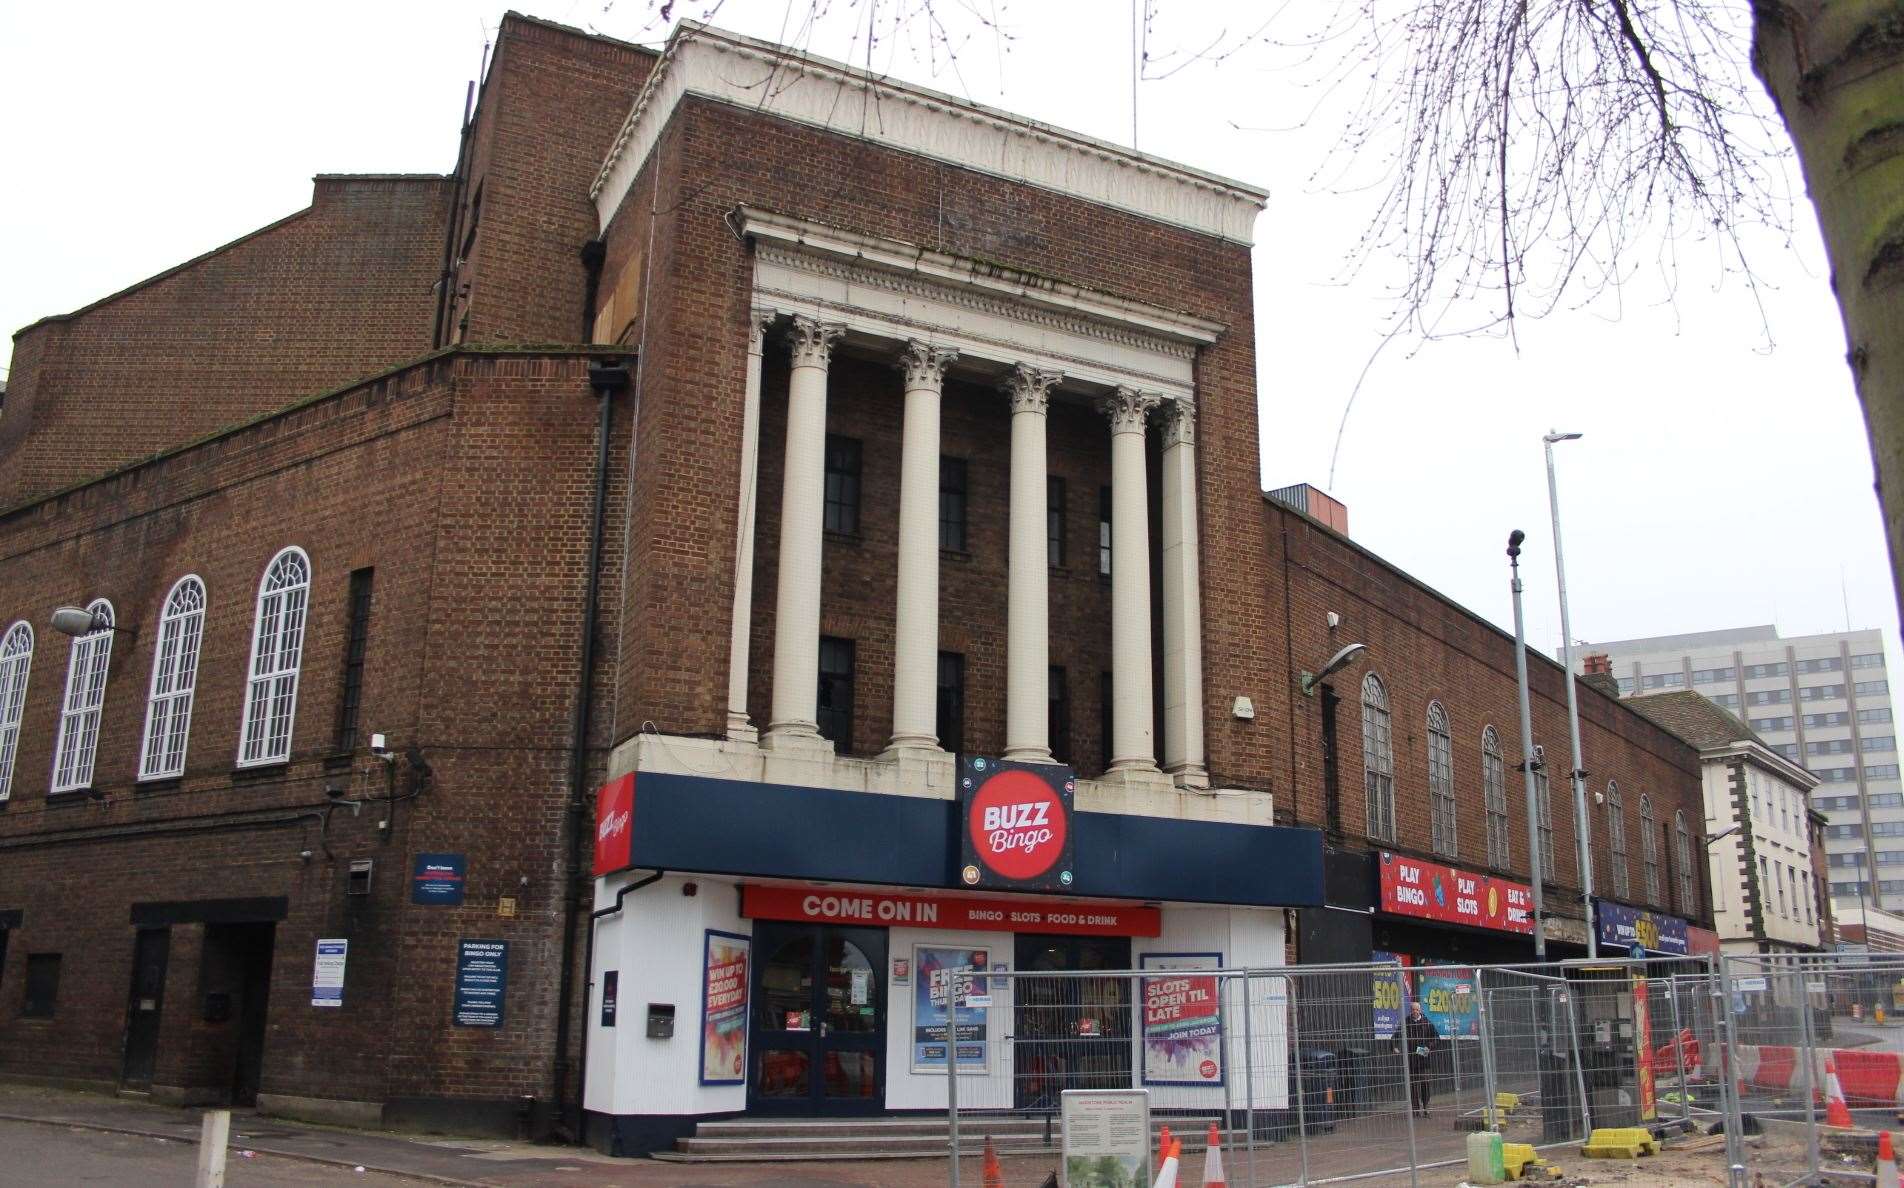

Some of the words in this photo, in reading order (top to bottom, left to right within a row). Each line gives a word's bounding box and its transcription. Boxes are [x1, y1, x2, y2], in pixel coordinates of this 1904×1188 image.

[984, 802, 1051, 831] BUZZ
[989, 829, 1053, 853] Bingo
[1400, 865, 1420, 884] PLAY
[1397, 886, 1425, 905] BINGO
[1458, 878, 1475, 895] PLAY
[1508, 889, 1519, 904] EAT
[1519, 893, 1525, 905] &
[803, 896, 873, 919] COME
[878, 900, 911, 920] ON
[916, 902, 937, 922] IN
[1457, 898, 1478, 915] SLOTS
[969, 910, 1003, 921] BINGO
[1010, 911, 1041, 923] SLOTS
[1047, 913, 1076, 924] FOOD
[1078, 915, 1085, 925] &
[1087, 916, 1117, 926] DRINK
[709, 967, 724, 981] WIN
[724, 966, 735, 978] UP
[735, 963, 744, 975] TO
[930, 965, 974, 987] FREE
[1148, 980, 1190, 997] SLOTS
[708, 988, 743, 1008] EVERYDAY
[1148, 993, 1187, 1008] OPEN
[1189, 989, 1209, 1003] TIL
[1148, 1007, 1180, 1021] LATE
[1168, 1030, 1188, 1040] JOIN
[1189, 1027, 1217, 1039] TODAY
